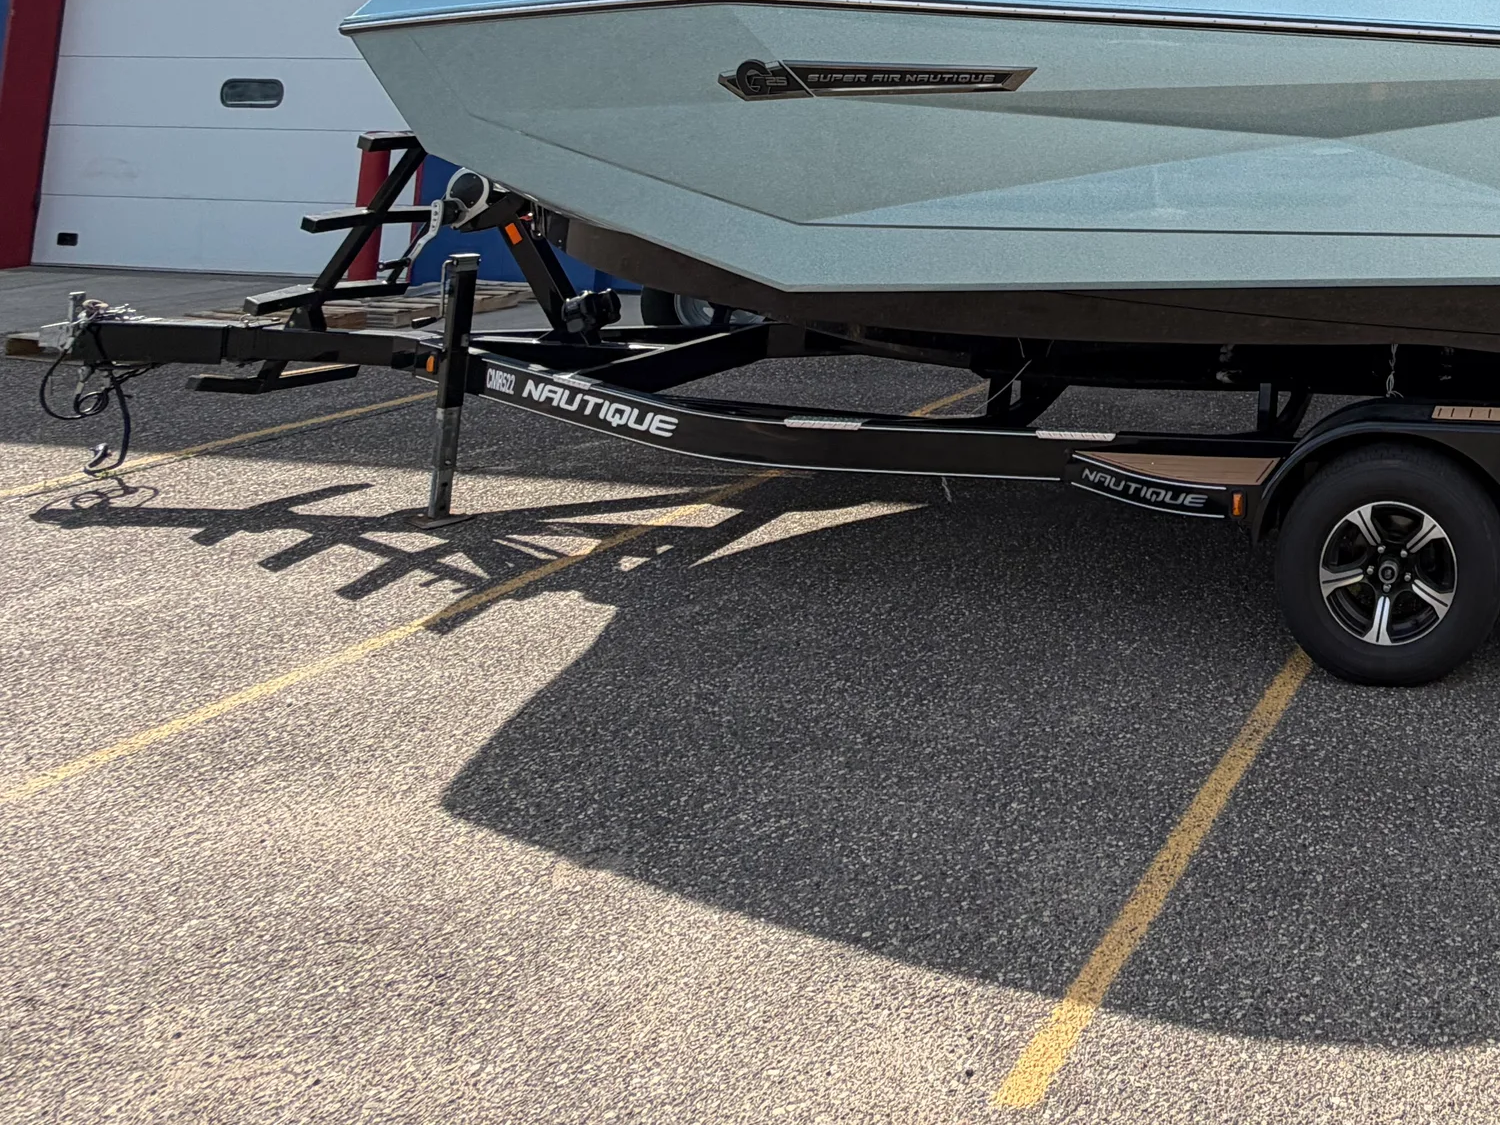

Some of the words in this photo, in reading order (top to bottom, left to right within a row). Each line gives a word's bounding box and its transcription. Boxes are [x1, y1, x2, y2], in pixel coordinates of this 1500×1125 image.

[807, 73, 867, 83] SUPER
[871, 73, 901, 83] AIR
[905, 73, 995, 83] NAUTIQUE
[521, 379, 679, 438] NAUTIQUE
[1082, 467, 1208, 508] NAUTIQUE
